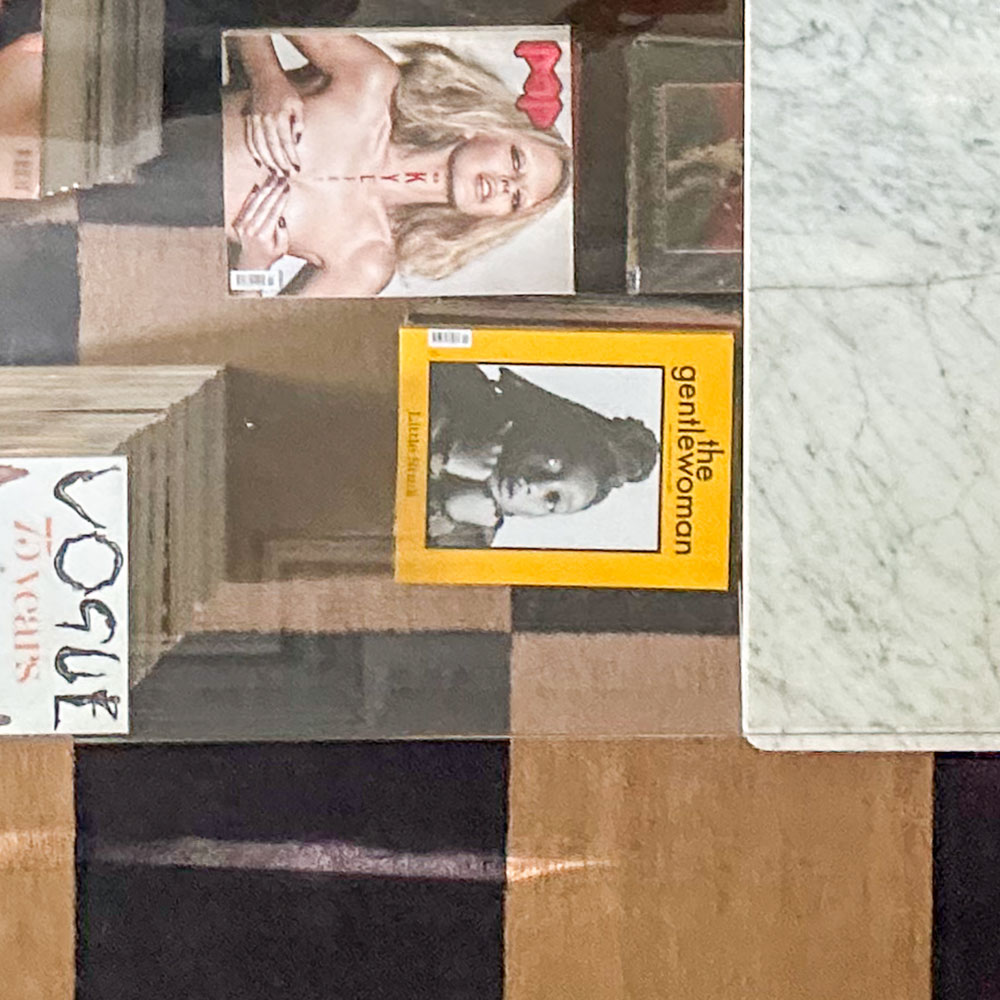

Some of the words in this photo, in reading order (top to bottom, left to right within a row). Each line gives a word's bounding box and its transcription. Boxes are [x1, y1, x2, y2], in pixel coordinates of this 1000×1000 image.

[671, 365, 706, 556] gentlewoman
[696, 440, 725, 482] the
[54, 465, 124, 730] VOGUE
